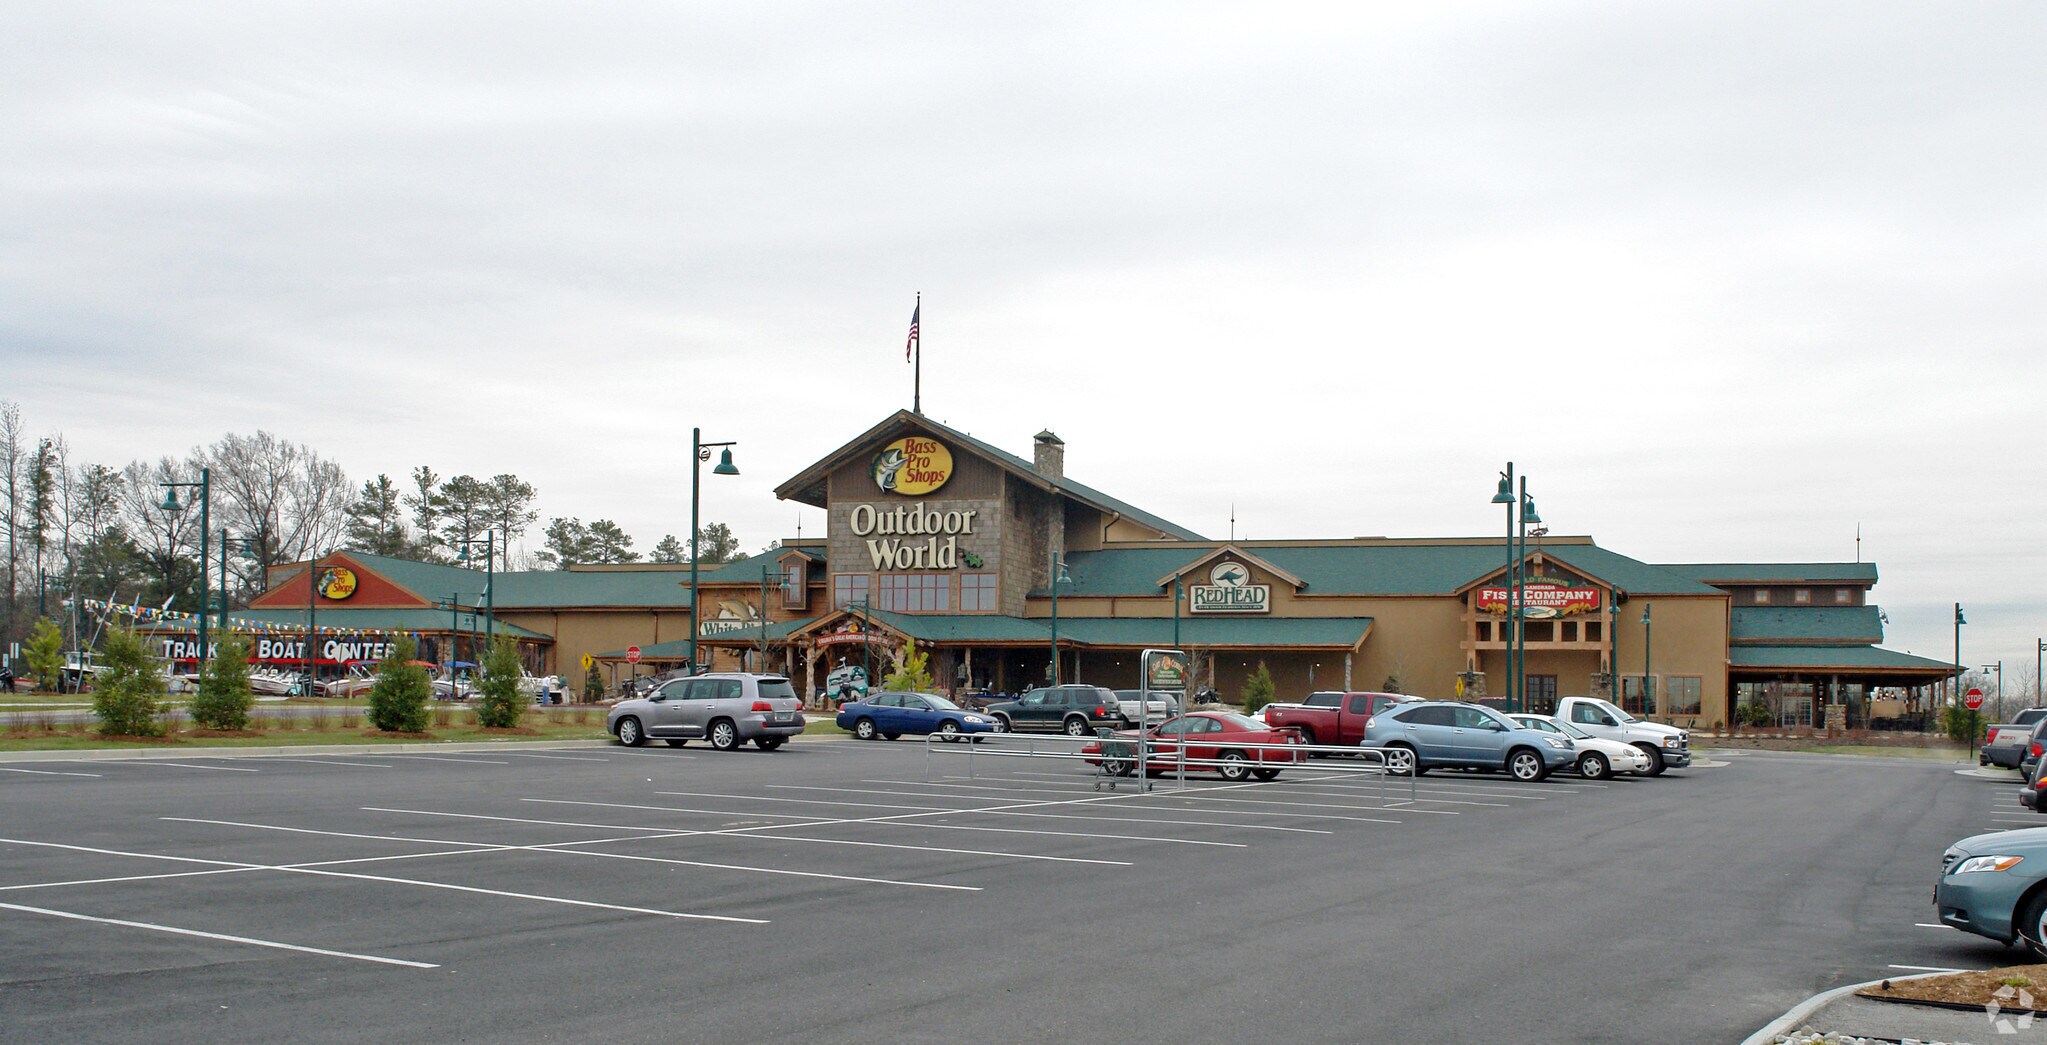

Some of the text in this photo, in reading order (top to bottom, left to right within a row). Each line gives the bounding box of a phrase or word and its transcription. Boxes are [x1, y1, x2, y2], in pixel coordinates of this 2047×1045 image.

[904, 439, 937, 454] Bass
[906, 454, 930, 469] Pro
[905, 468, 945, 486] Shops
[850, 502, 977, 536] Outdoor
[866, 536, 958, 570] World
[333, 583, 353, 594] Shops
[1538, 577, 1569, 587] FAMOUS
[1523, 590, 1594, 600] COMPANY
[258, 639, 305, 659] BOAT
[1965, 694, 1982, 704] STOP
